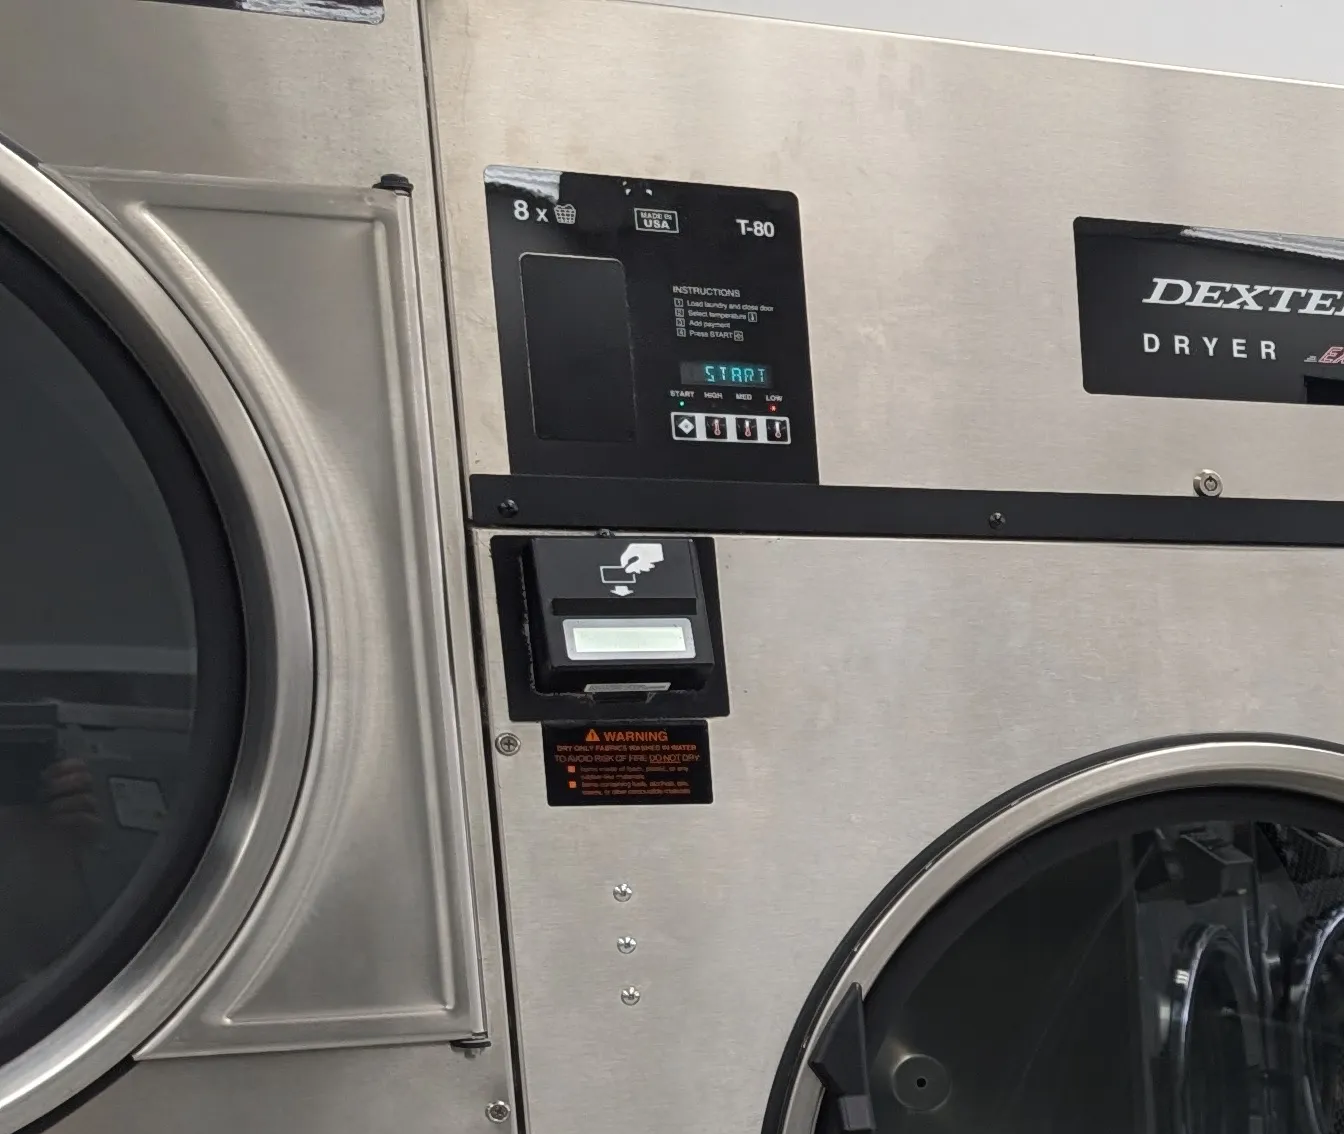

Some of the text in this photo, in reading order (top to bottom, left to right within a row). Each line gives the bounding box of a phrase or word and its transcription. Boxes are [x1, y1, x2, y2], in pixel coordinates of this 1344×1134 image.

[514, 200, 549, 222] 8 x
[644, 219, 670, 230] USA
[736, 219, 774, 237] T-80
[672, 286, 740, 298] INSTRUCTIONS
[1143, 332, 1276, 360] DRYER
[705, 366, 766, 382] START
[670, 390, 695, 398] START
[765, 394, 783, 402] LOW
[604, 731, 668, 742] WARNING
